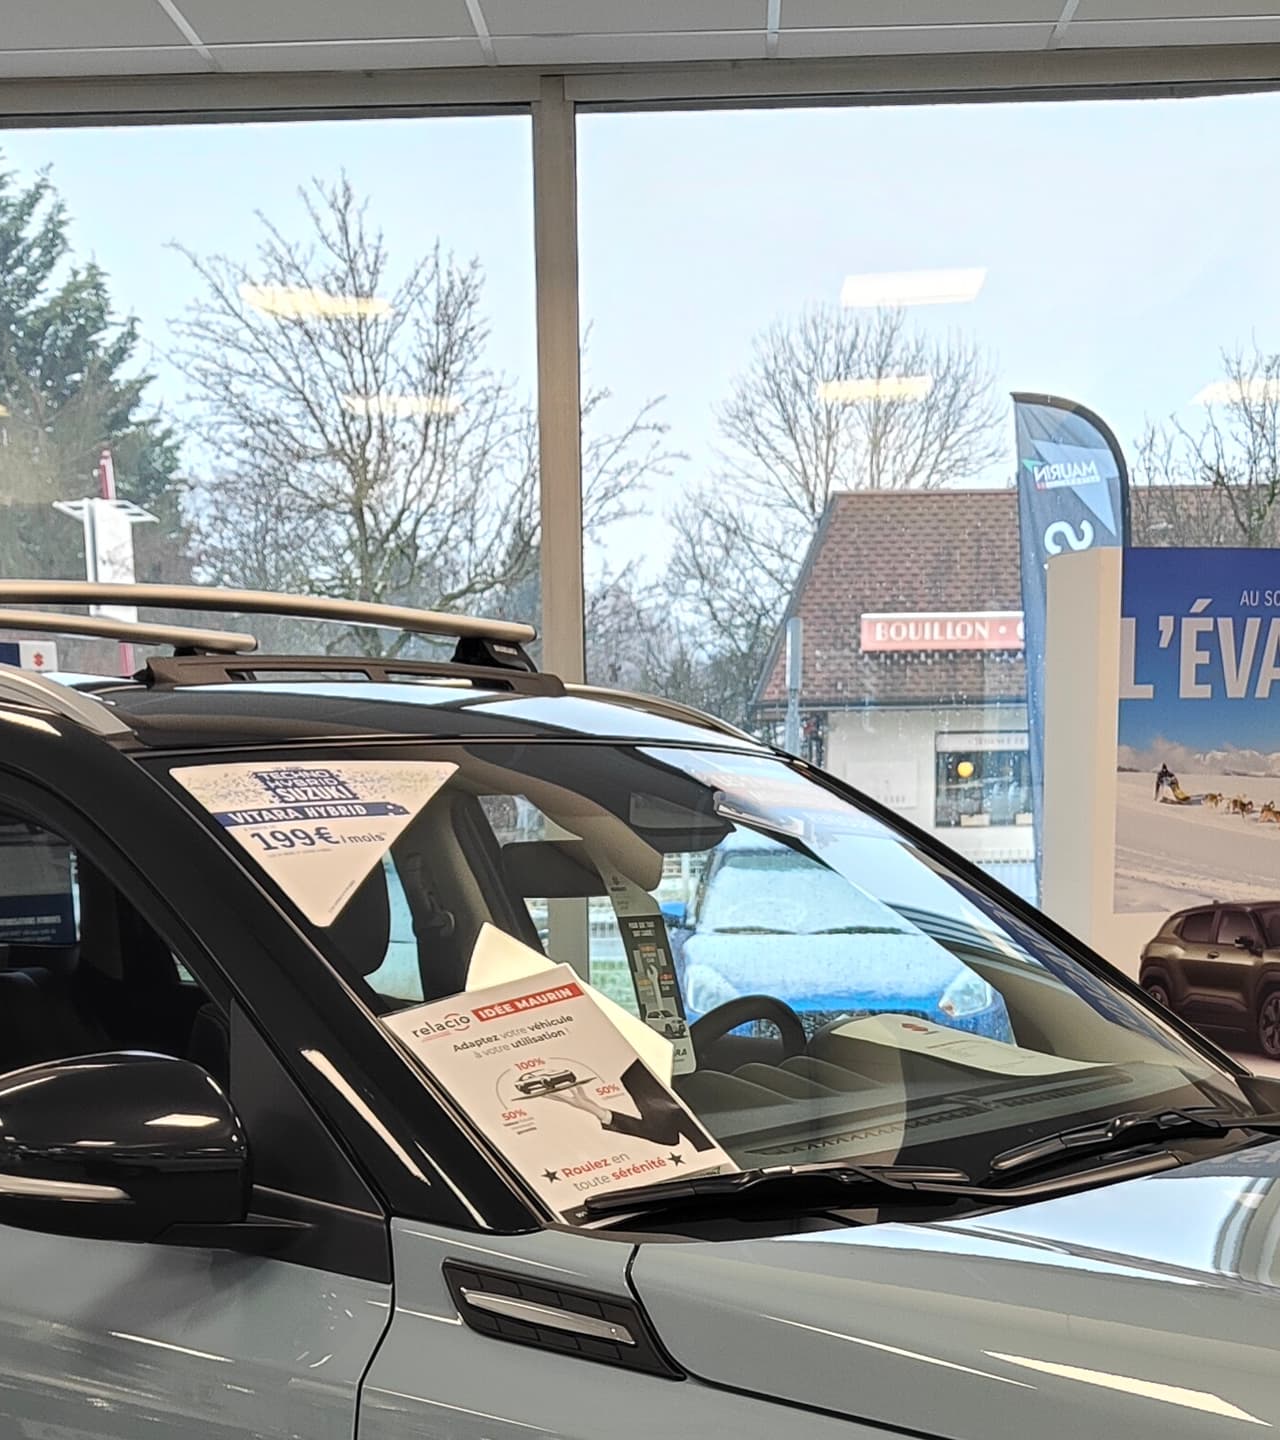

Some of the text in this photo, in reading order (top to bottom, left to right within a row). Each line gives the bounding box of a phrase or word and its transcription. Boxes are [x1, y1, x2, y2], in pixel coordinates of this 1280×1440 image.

[1240, 590, 1259, 607] AU
[875, 621, 991, 641] BOUILLON
[257, 769, 331, 780] TECHNO
[266, 778, 339, 788] HYBRID
[274, 785, 354, 802] SUZUKI
[228, 804, 368, 825] VITARA HYBRID
[251, 826, 340, 851] 199€
[478, 987, 573, 1020] IDÉE MAURIN
[412, 1015, 470, 1038] relacio
[453, 1034, 500, 1052] Adaptez
[500, 1026, 527, 1040] votre
[527, 1014, 574, 1032] véhicule
[483, 1043, 510, 1056] votre
[514, 1057, 545, 1071] 100%
[595, 1083, 620, 1096] 50%
[502, 1109, 527, 1121] 50%
[561, 1151, 631, 1178] Roulez en
[573, 1157, 668, 1192] toute sérénité
